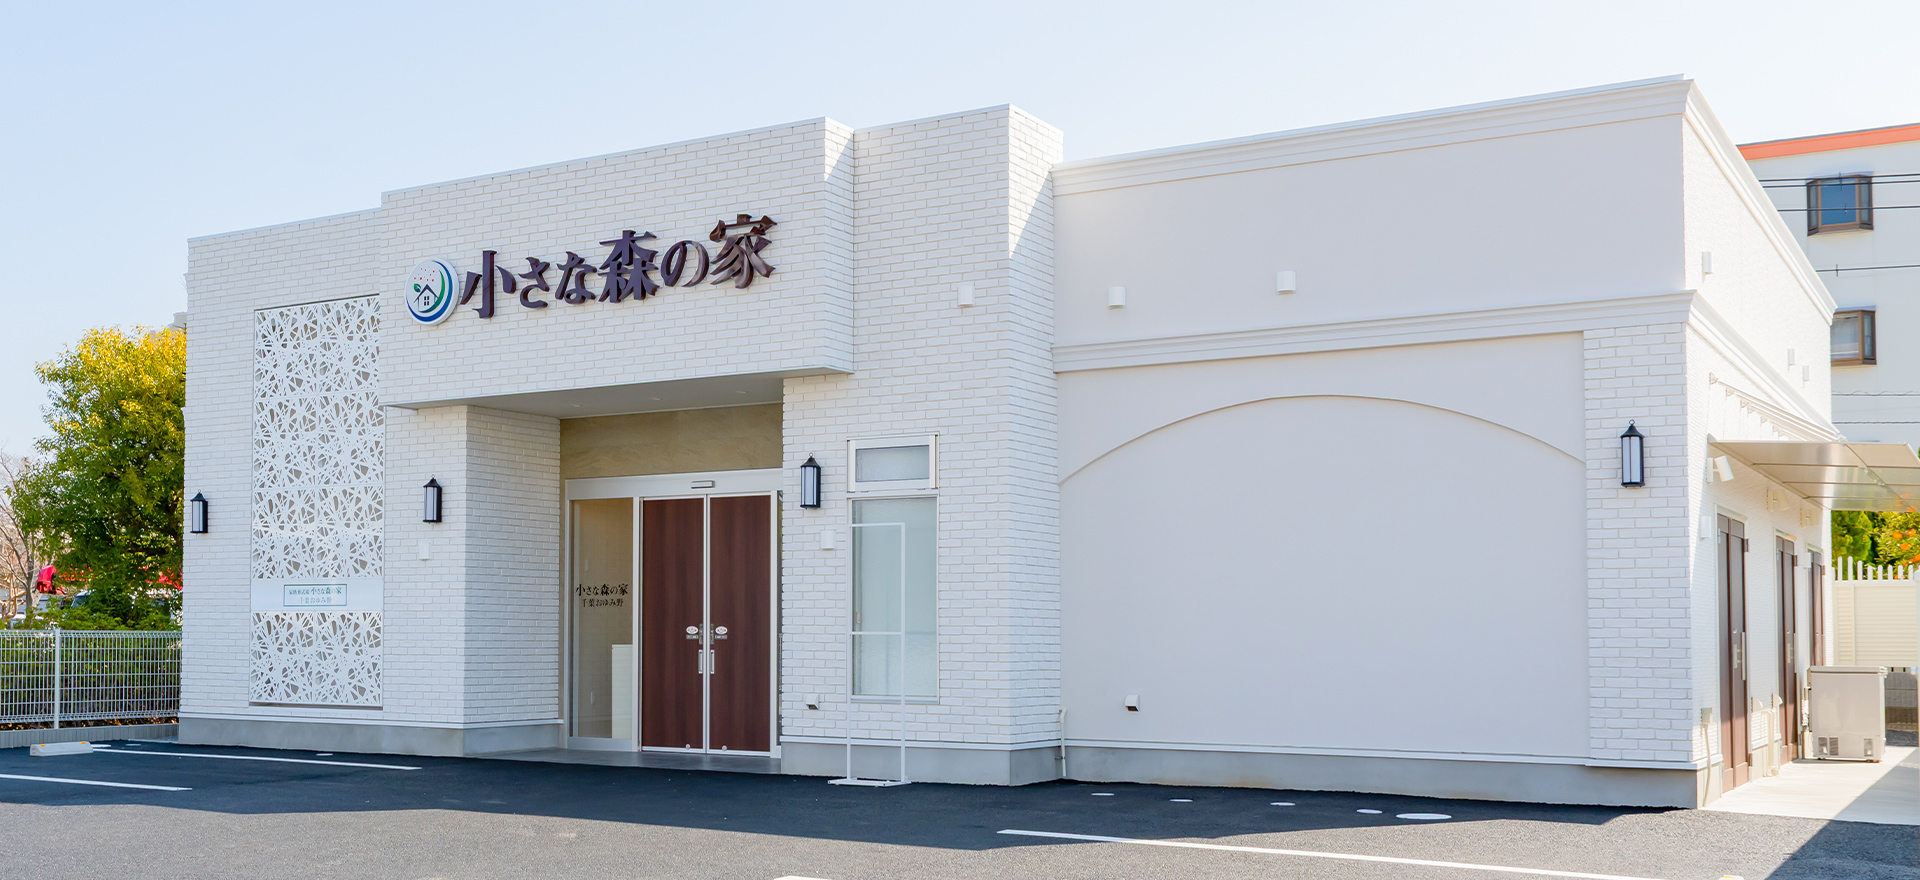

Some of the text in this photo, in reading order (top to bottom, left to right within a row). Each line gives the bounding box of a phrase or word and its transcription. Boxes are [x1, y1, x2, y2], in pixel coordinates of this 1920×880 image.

[460, 213, 778, 318] 小さな森の家
[310, 586, 342, 595] 小さな森の家
[575, 583, 628, 596] 小さな森の家
[583, 598, 624, 607] 千葉おゆみ野
